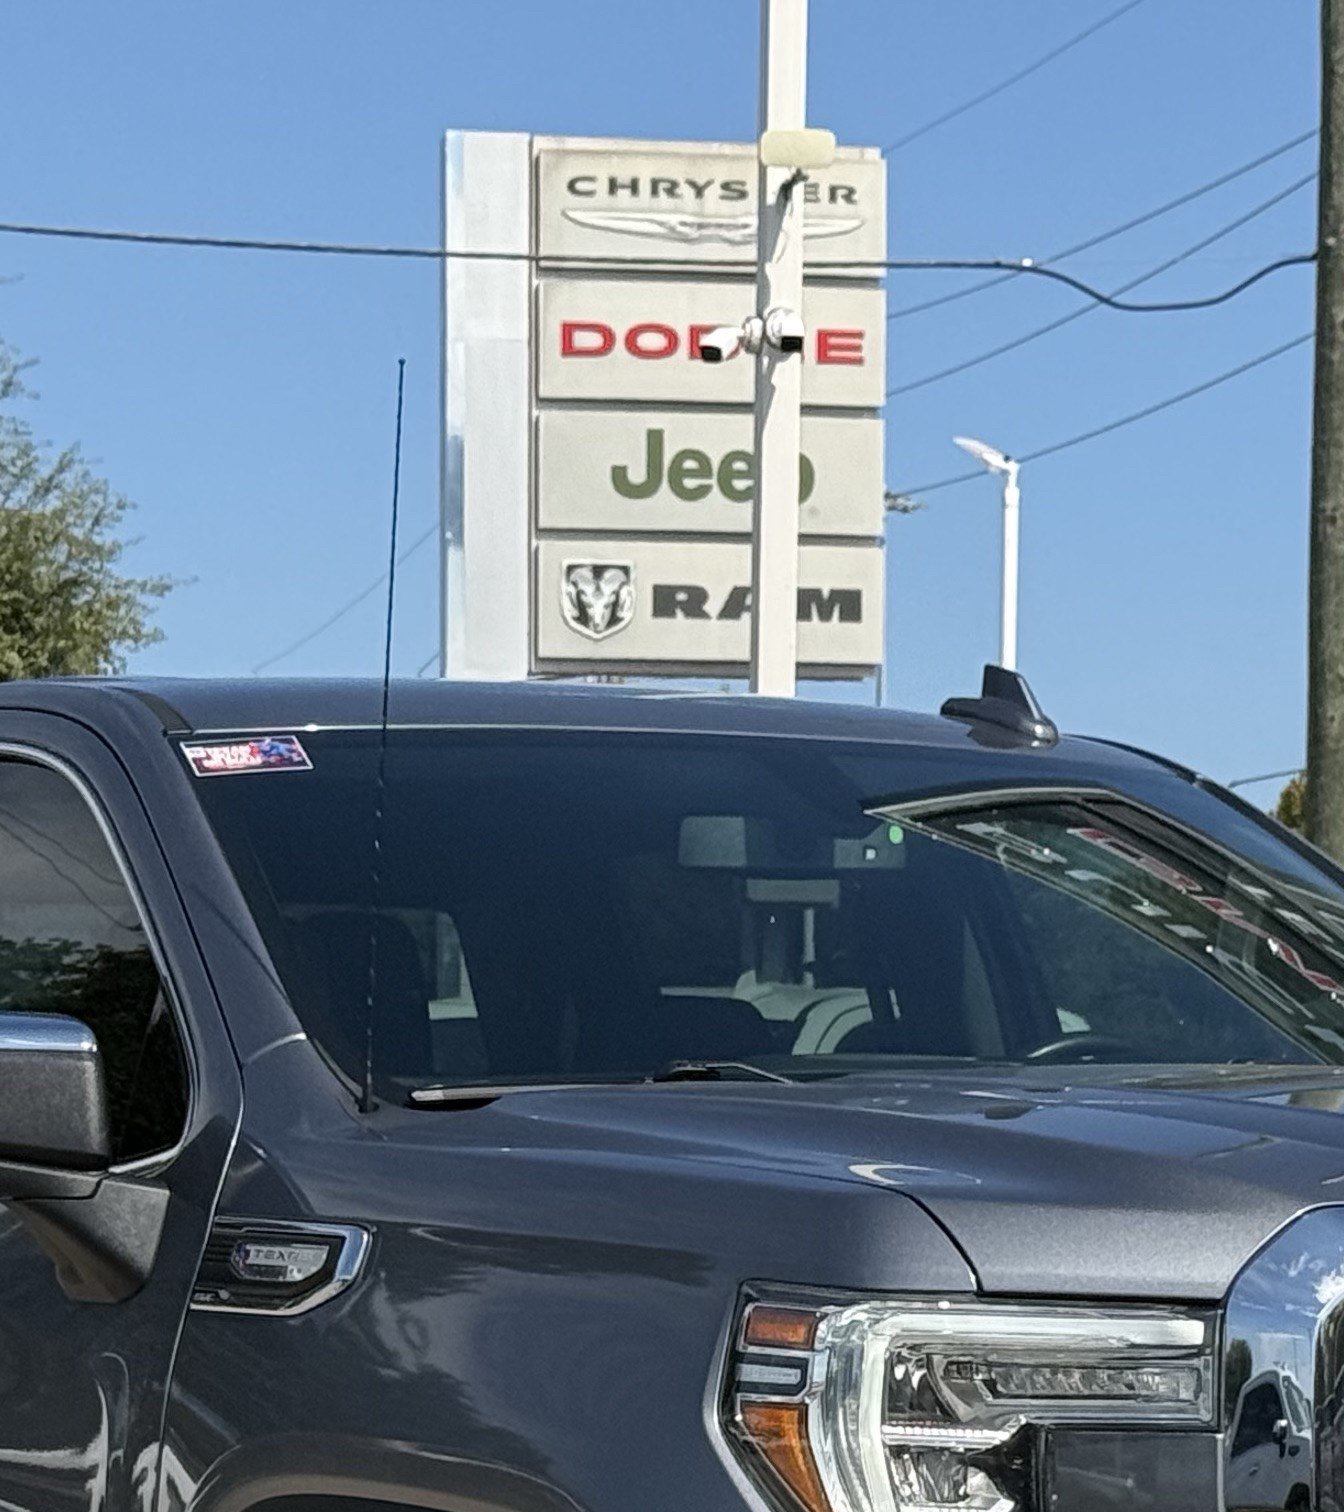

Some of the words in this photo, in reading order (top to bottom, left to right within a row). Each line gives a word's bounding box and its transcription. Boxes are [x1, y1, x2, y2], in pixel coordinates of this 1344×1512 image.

[566, 174, 858, 205] CHRYSER
[560, 319, 865, 367] DOE
[611, 427, 815, 505] Jee
